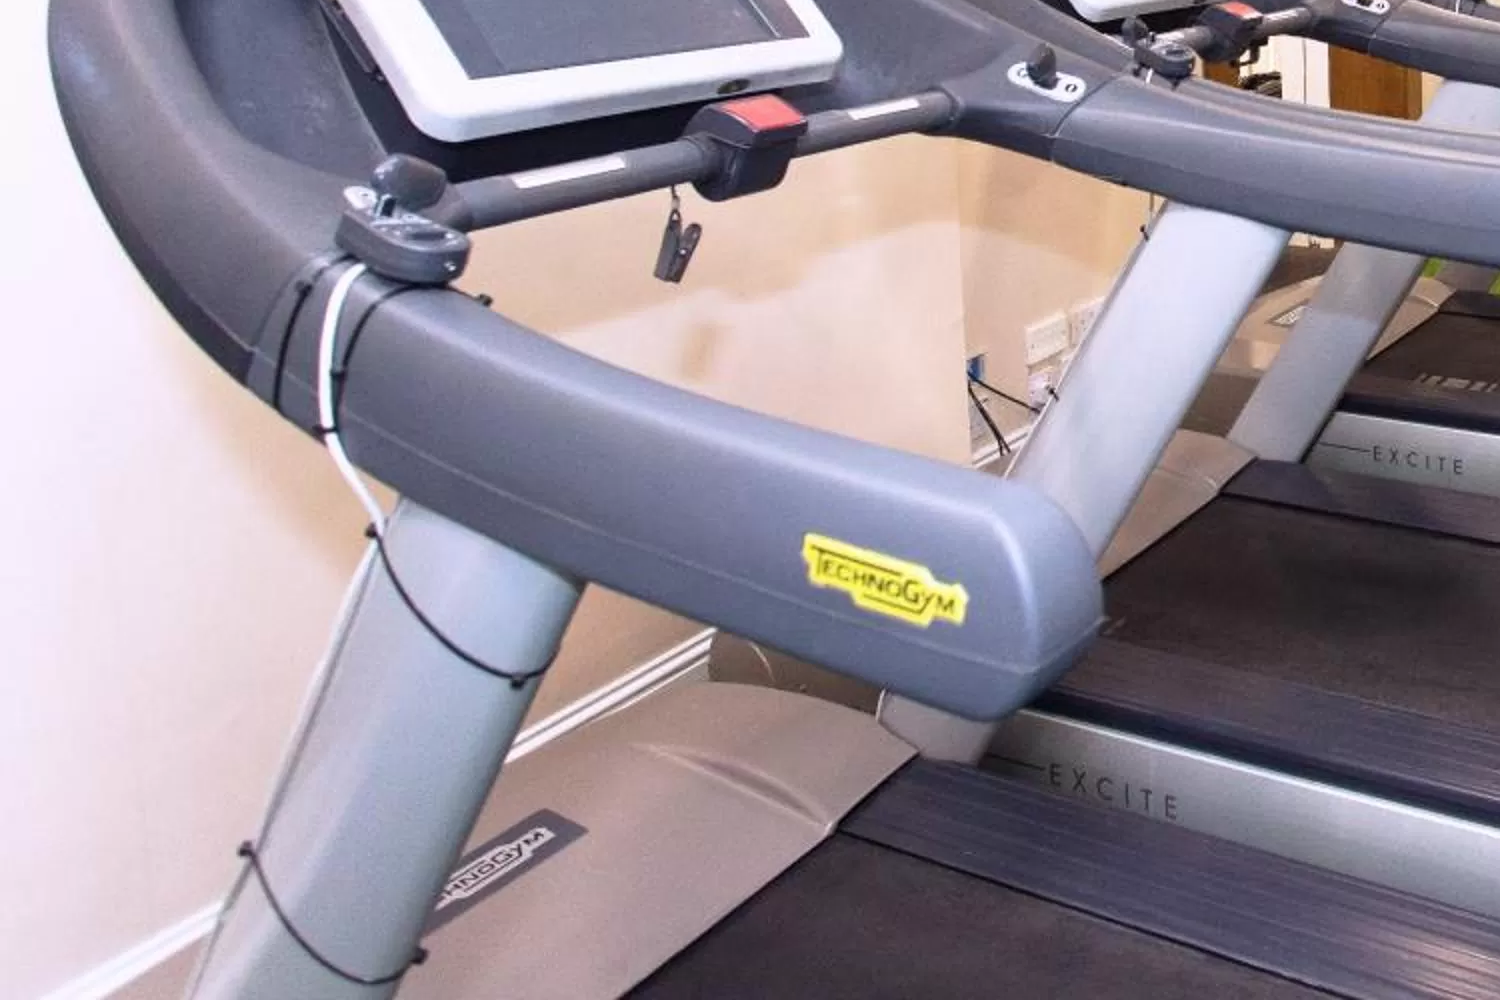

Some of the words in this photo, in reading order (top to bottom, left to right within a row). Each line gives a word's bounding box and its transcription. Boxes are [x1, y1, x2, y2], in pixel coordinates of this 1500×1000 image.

[1372, 446, 1464, 475] EXCITE
[811, 544, 956, 615] TECHNOGYM
[1049, 762, 1178, 820] EXCITE
[441, 831, 545, 897] HNOGYM
